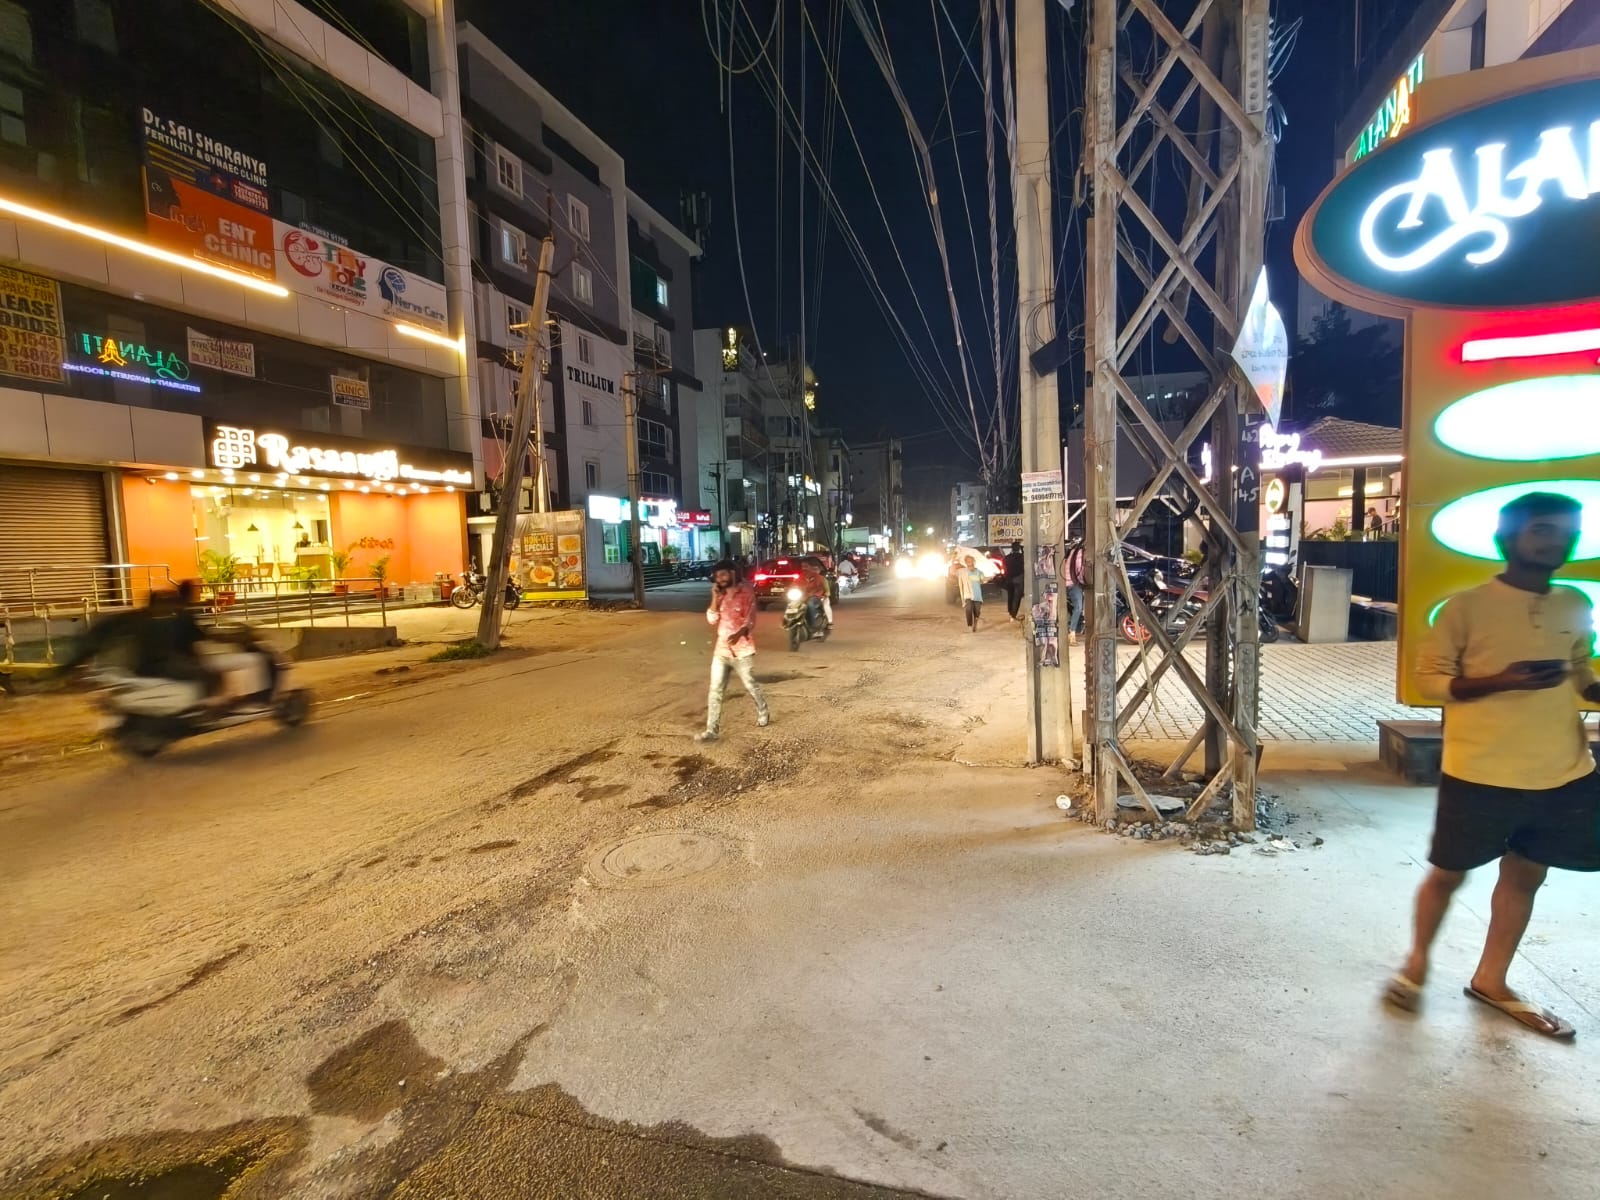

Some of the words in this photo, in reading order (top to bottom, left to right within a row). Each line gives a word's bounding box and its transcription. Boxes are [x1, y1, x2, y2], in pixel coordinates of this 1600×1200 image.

[144, 126, 194, 156] FERTILITY
[240, 168, 268, 188] CLINIC
[168, 120, 193, 143] SAI
[196, 132, 267, 177] SHARANYA
[1360, 121, 1600, 272] ALA
[218, 217, 256, 245] ENT
[204, 233, 272, 270] CLINIC
[395, 295, 423, 314] Nerve
[424, 306, 446, 321] Care
[336, 383, 367, 397] CLINICS
[566, 365, 615, 395] TRILLIUM
[1240, 466, 1255, 484] A
[1238, 487, 1260, 502] 45
[523, 534, 554, 545] NON-VEG
[524, 543, 554, 553] SPECIALS
